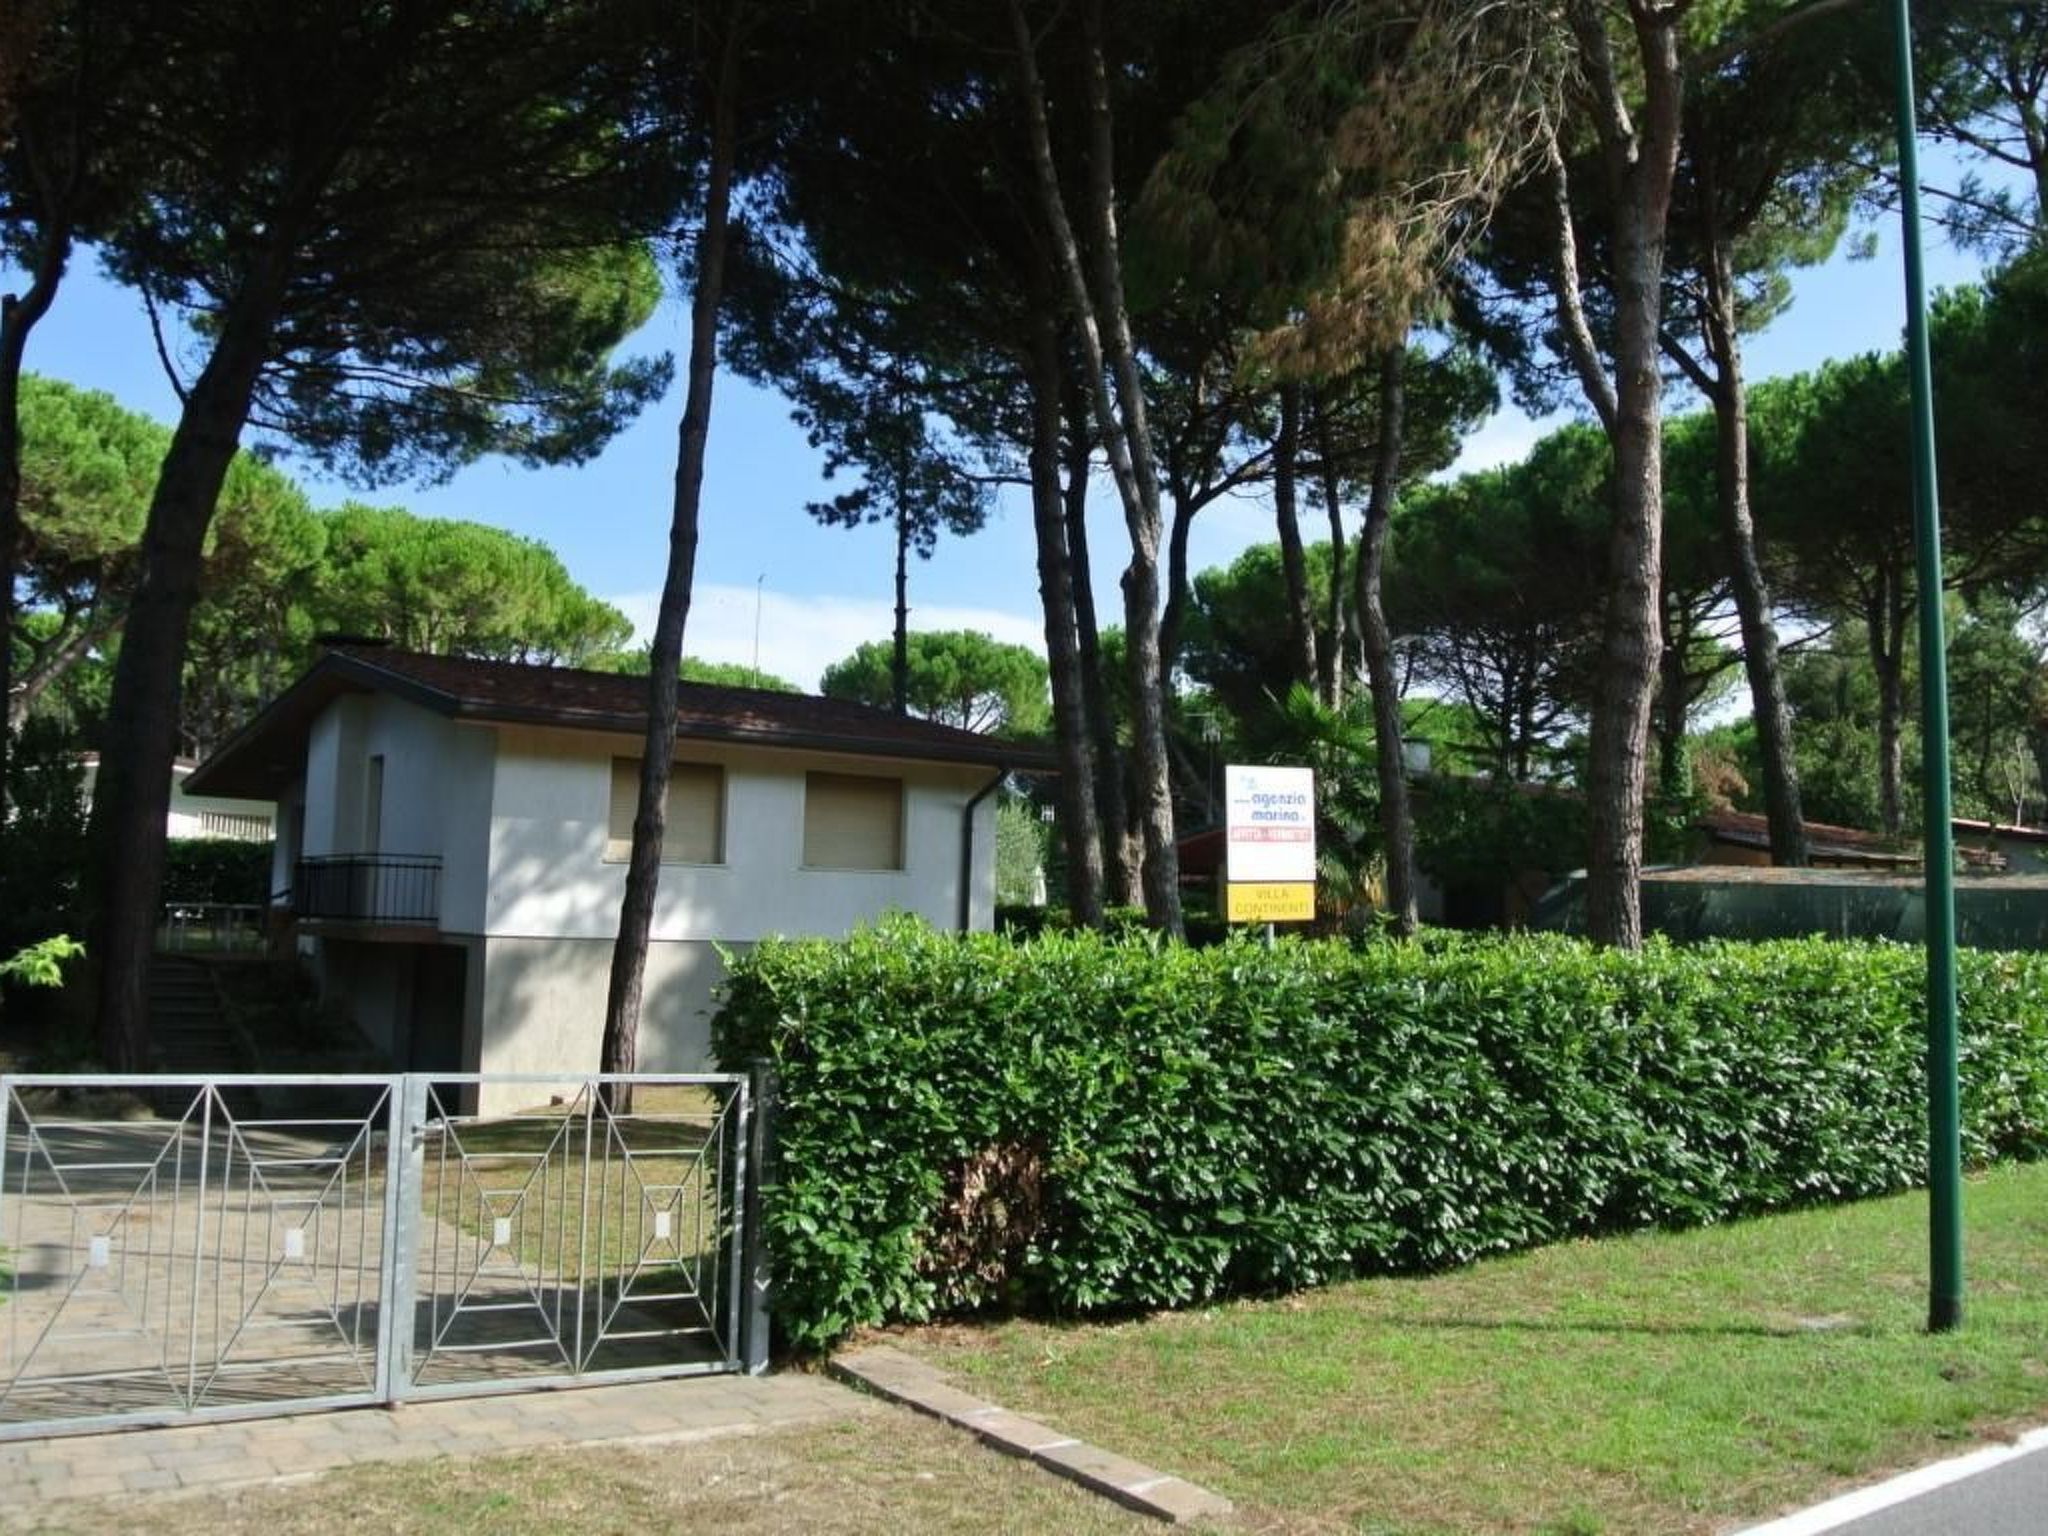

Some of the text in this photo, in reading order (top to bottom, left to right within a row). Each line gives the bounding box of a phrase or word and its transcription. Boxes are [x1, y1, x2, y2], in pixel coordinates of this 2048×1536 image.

[1251, 792, 1306, 809] agenzia
[1251, 807, 1299, 821] marina
[1256, 888, 1289, 899] VILLA
